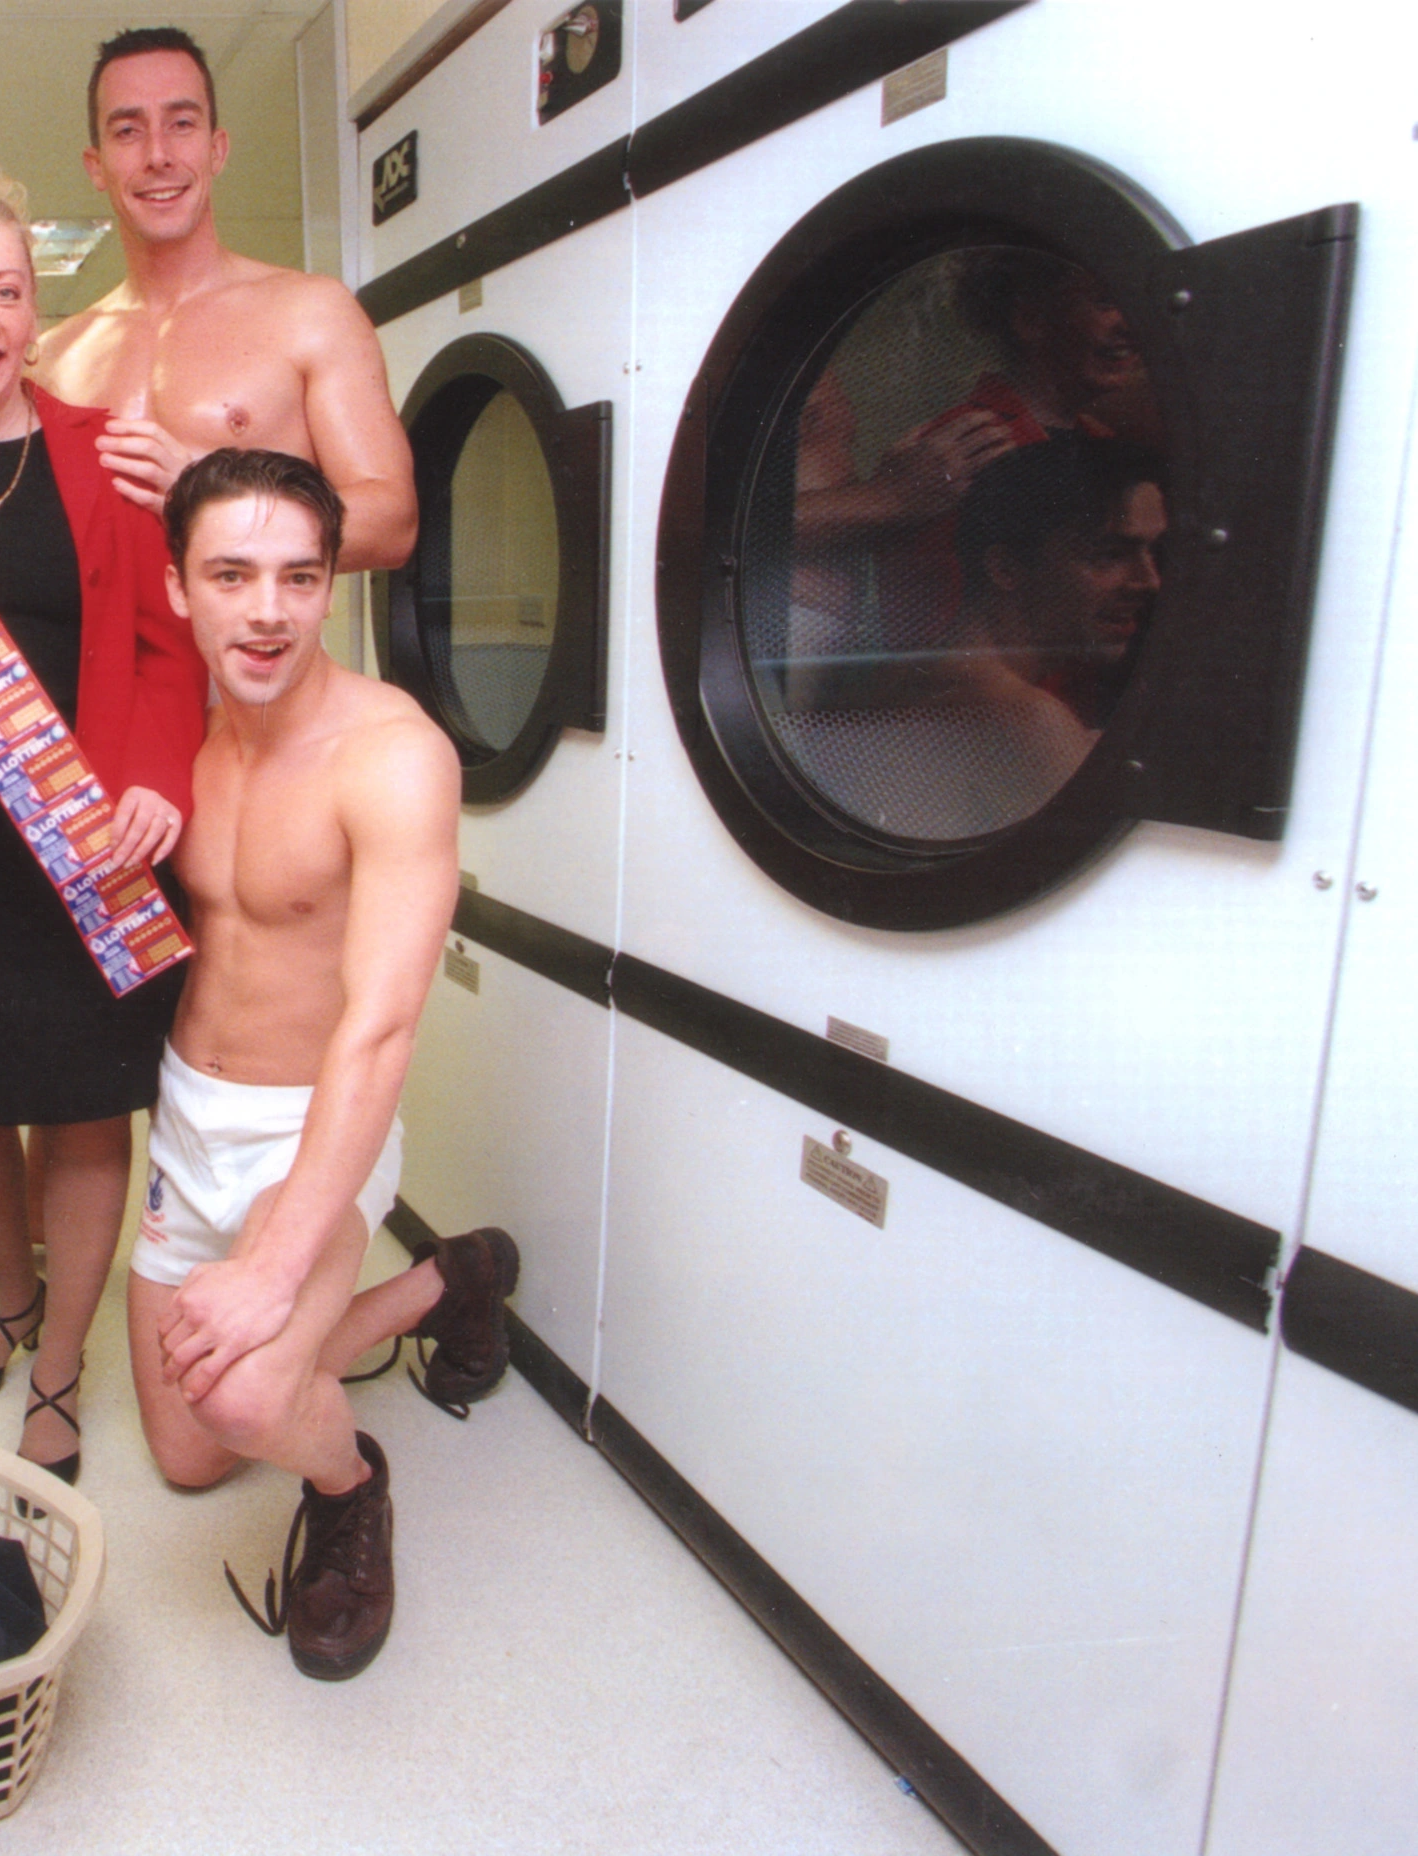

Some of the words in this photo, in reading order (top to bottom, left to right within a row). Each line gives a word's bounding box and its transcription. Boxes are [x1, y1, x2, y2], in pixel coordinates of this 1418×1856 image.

[1, 733, 53, 772] LOTTERY
[39, 794, 91, 833] LOTTERY
[76, 867, 115, 892] LOTTE
[103, 908, 153, 946] LOTTERY
